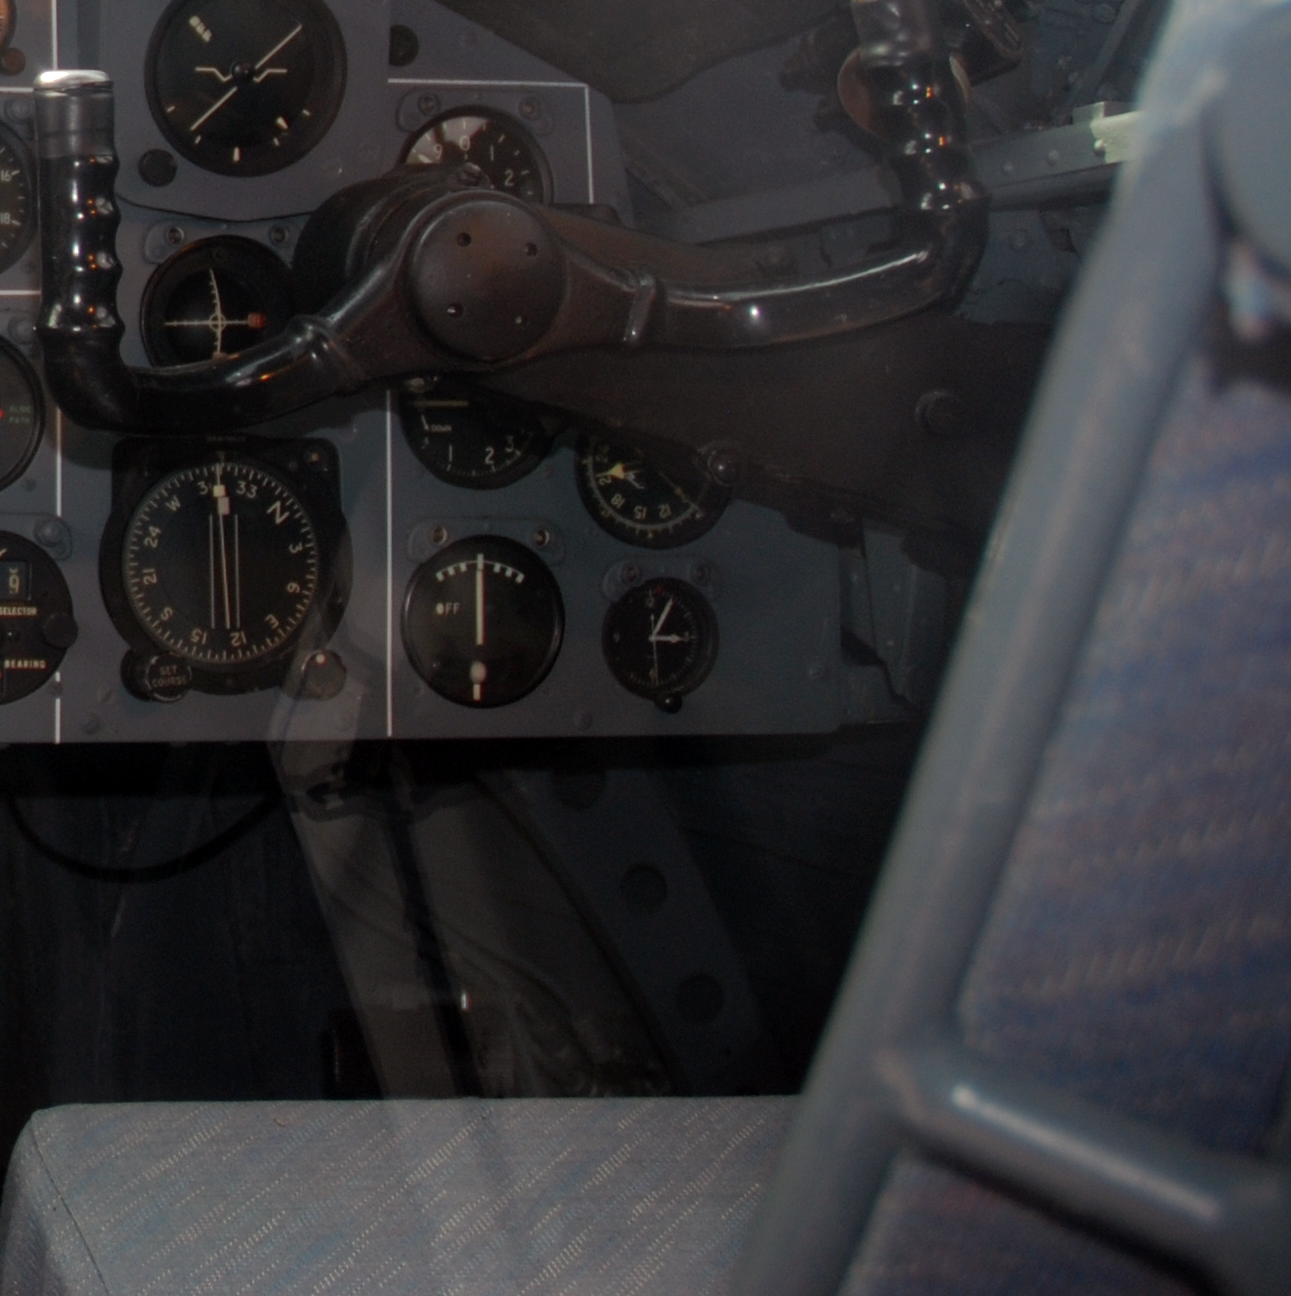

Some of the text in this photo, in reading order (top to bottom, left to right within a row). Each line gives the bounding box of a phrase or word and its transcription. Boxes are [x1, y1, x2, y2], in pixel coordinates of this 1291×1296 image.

[503, 169, 514, 187] 2
[236, 481, 258, 498] 33
[266, 500, 290, 525] N
[144, 525, 162, 549] 24
[143, 568, 158, 586] 21
[435, 602, 460, 615] OFF
[190, 628, 208, 644] 15
[230, 631, 247, 647] 12
[4, 660, 46, 668] BEARING
